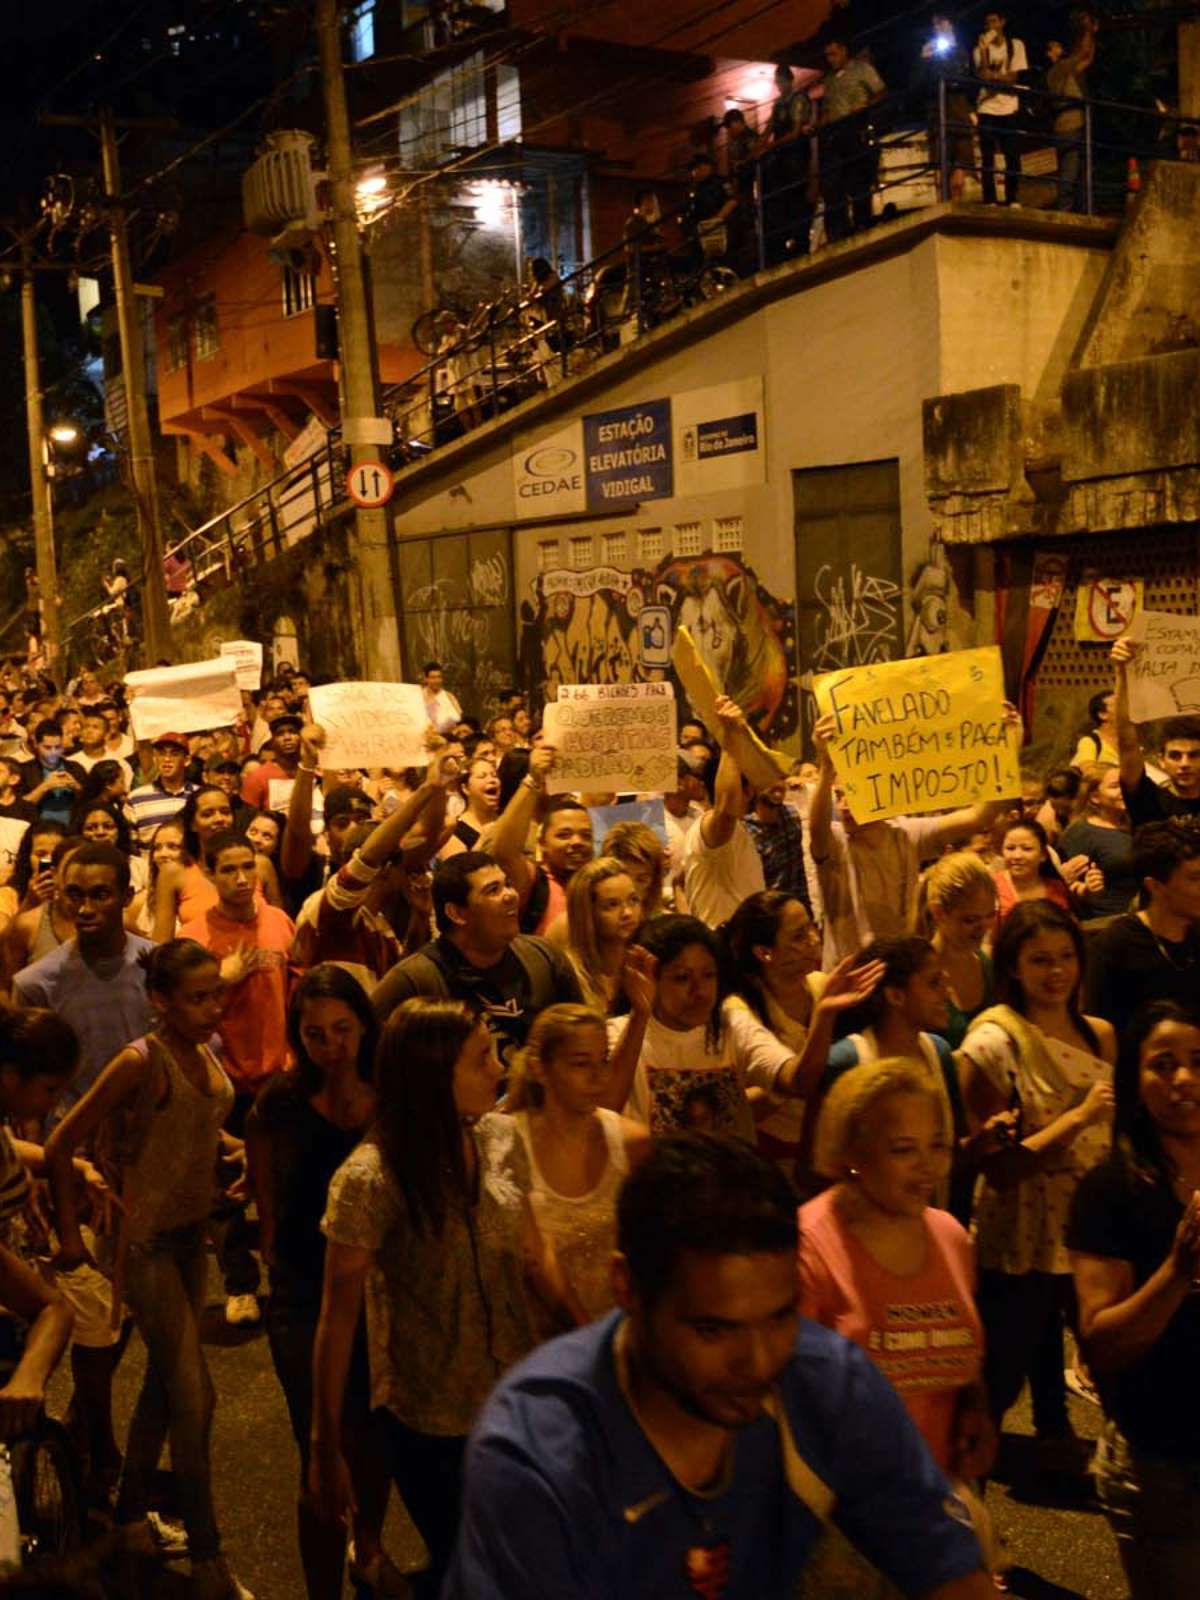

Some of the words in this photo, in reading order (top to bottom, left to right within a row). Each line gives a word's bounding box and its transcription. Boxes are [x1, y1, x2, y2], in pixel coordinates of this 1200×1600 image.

[598, 413, 655, 443] ESTAÇÃO
[590, 442, 666, 473] ELEVATÓRIA
[519, 475, 582, 499] CEDAE
[602, 475, 655, 499] VIDIGAL
[829, 675, 951, 735] FAVELADO
[839, 726, 940, 768] TAMBÉM
[960, 720, 1009, 750] PAGA
[866, 753, 1004, 813] IMPOSTO!
